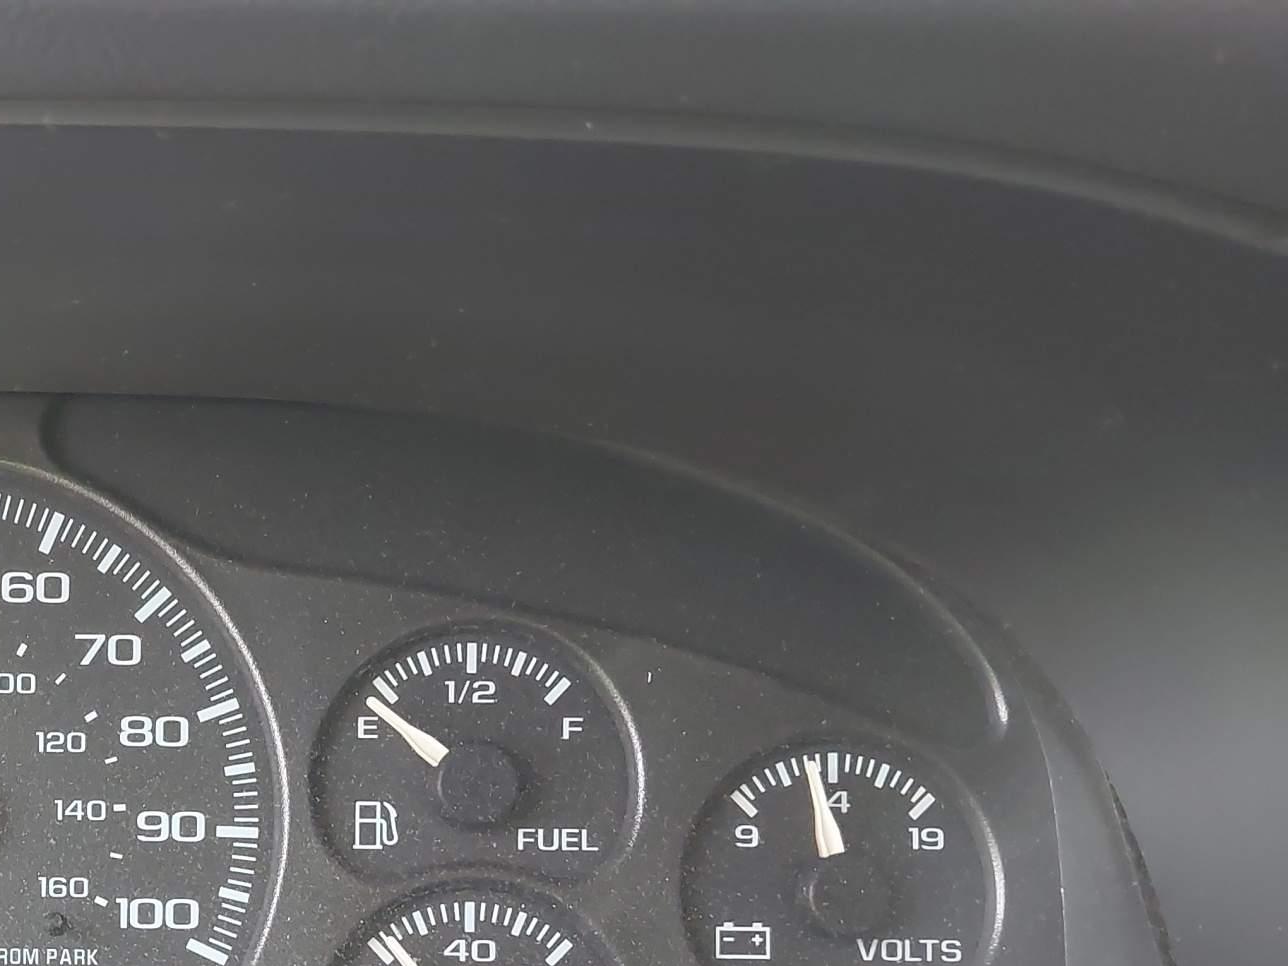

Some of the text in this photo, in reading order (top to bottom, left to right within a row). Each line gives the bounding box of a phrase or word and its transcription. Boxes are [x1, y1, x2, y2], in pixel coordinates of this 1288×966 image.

[1, 571, 70, 604] 60
[74, 633, 142, 666] 70
[444, 680, 496, 704] 1/2
[119, 715, 189, 747] 80
[357, 716, 379, 739] E
[562, 717, 584, 740] F
[35, 731, 86, 753] 120
[54, 799, 106, 821] 140
[136, 810, 206, 843] 90
[734, 824, 759, 848] 9
[517, 828, 599, 851] FUEL
[908, 827, 945, 850] 19
[37, 876, 89, 898] 160
[115, 897, 200, 930] 100
[46, 948, 98, 966] PARK
[443, 939, 496, 962] 40
[857, 939, 962, 963] VOLTS
